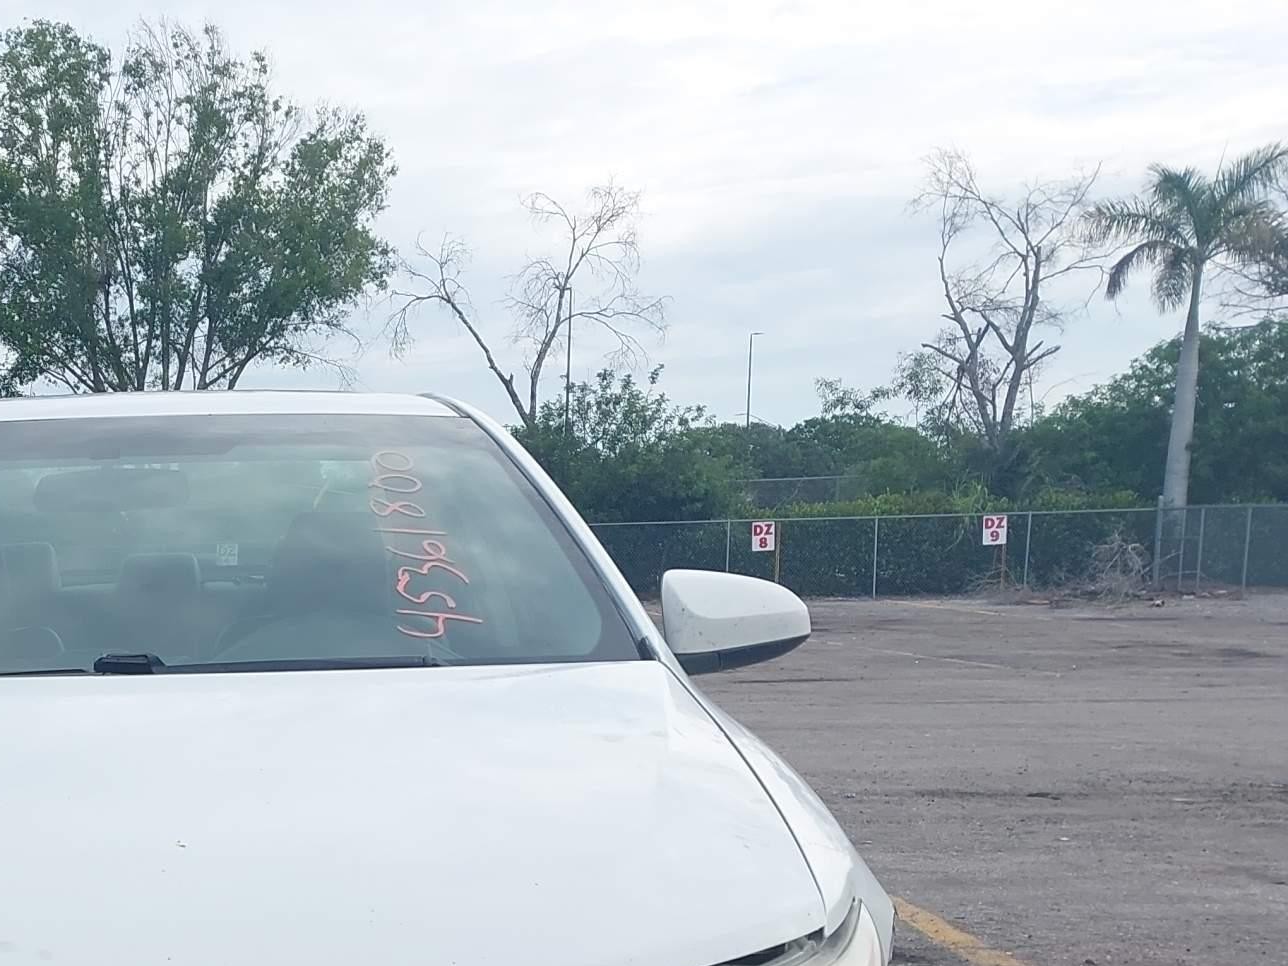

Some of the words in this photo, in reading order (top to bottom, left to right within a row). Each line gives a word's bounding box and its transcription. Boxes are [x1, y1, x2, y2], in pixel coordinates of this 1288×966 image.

[985, 517, 1005, 529] DZ
[754, 524, 773, 537] DZ
[990, 530, 1000, 542] 9
[368, 451, 484, 638] 45361800
[759, 537, 768, 548] 8
